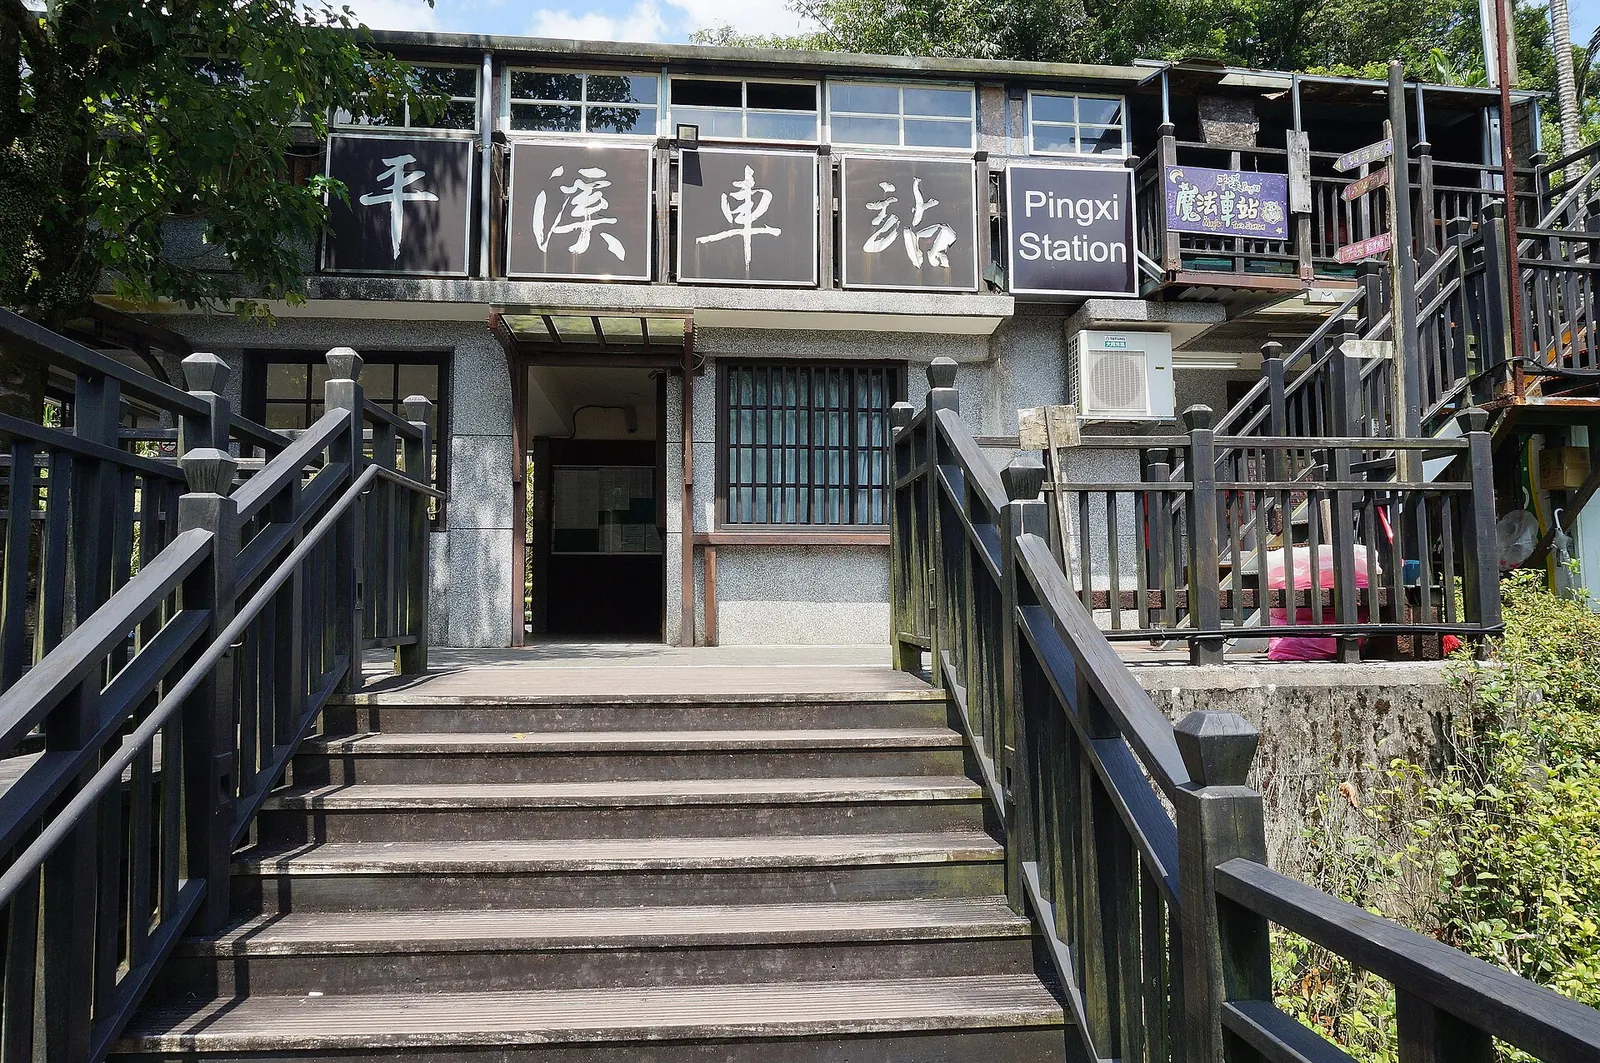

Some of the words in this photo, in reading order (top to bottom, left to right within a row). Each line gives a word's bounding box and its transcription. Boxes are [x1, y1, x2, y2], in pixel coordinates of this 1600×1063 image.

[1024, 189, 1119, 227] Pingxi
[1175, 181, 1260, 228] 魔法車站
[1018, 231, 1127, 264] Station
